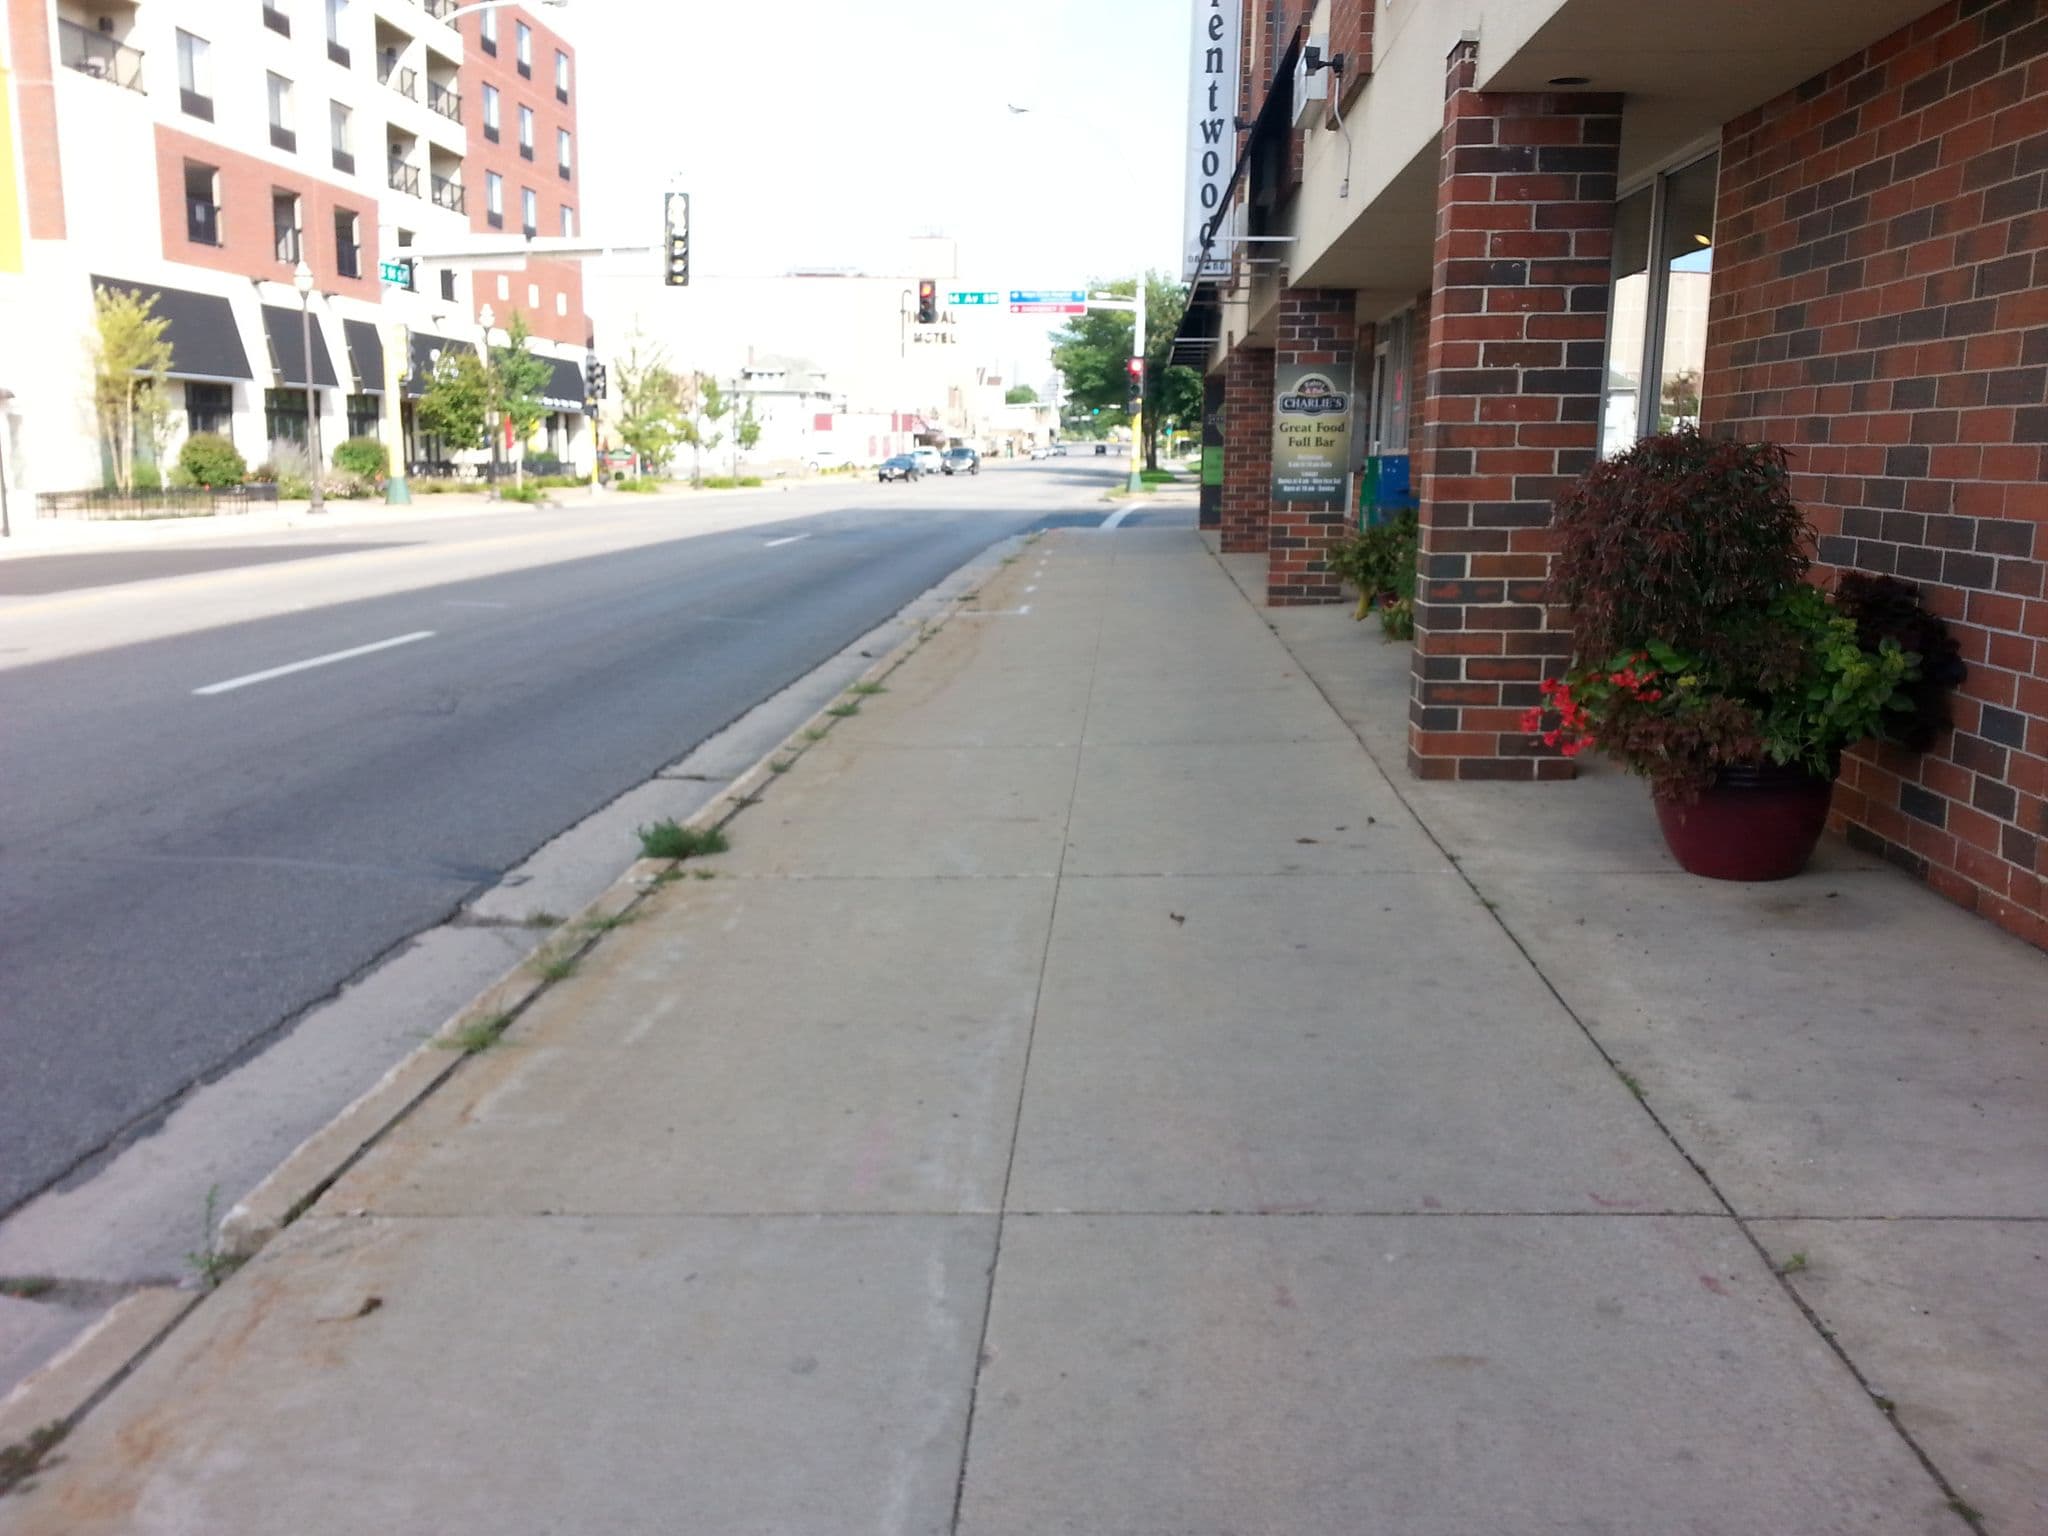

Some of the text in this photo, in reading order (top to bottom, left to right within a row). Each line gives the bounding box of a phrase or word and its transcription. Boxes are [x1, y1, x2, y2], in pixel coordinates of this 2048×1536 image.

[914, 331, 957, 344] MOTEL
[1284, 398, 1342, 408] CHARLIE'S
[1279, 422, 1345, 432] Great Food
[1288, 437, 1335, 447] Full Bar
